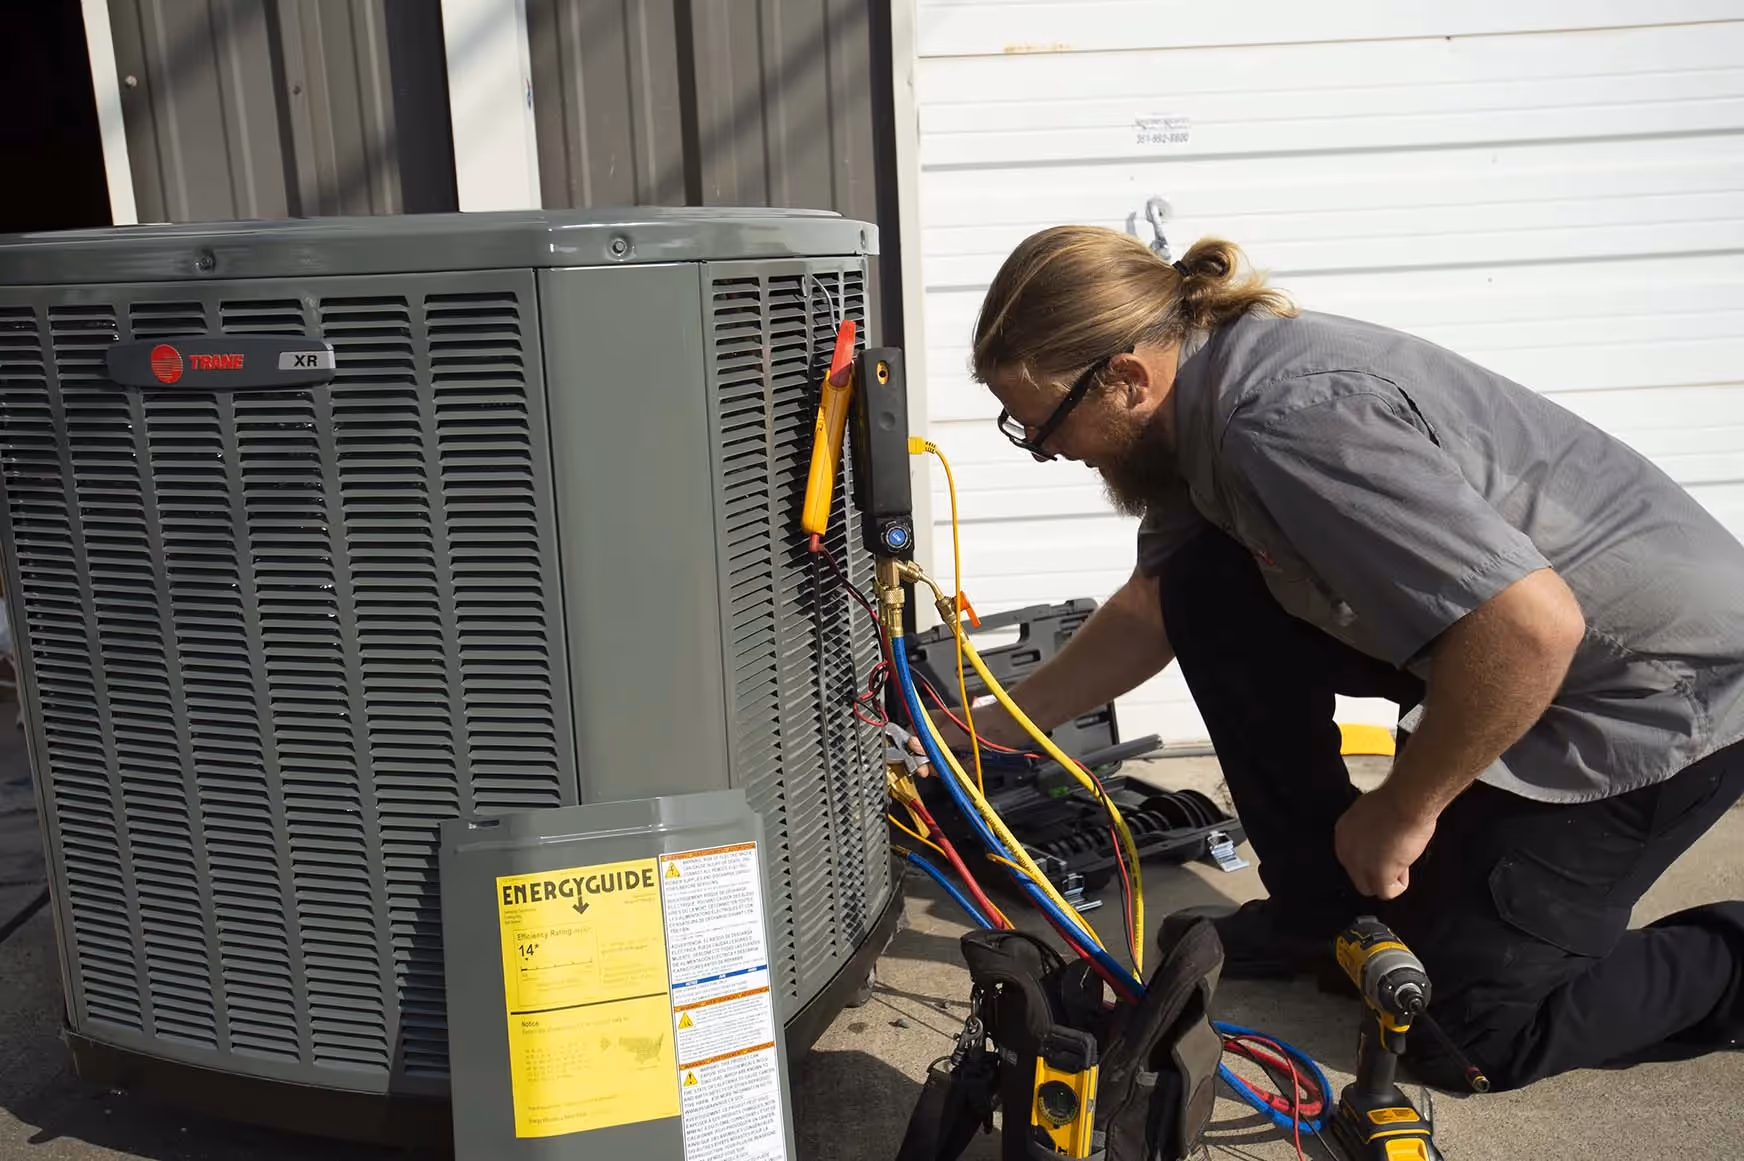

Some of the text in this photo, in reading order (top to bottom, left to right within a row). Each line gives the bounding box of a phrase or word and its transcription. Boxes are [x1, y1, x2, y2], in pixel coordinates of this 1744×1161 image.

[188, 353, 245, 371] TRANE
[293, 354, 318, 368] XR
[503, 868, 655, 905] ENERGYGUIDE
